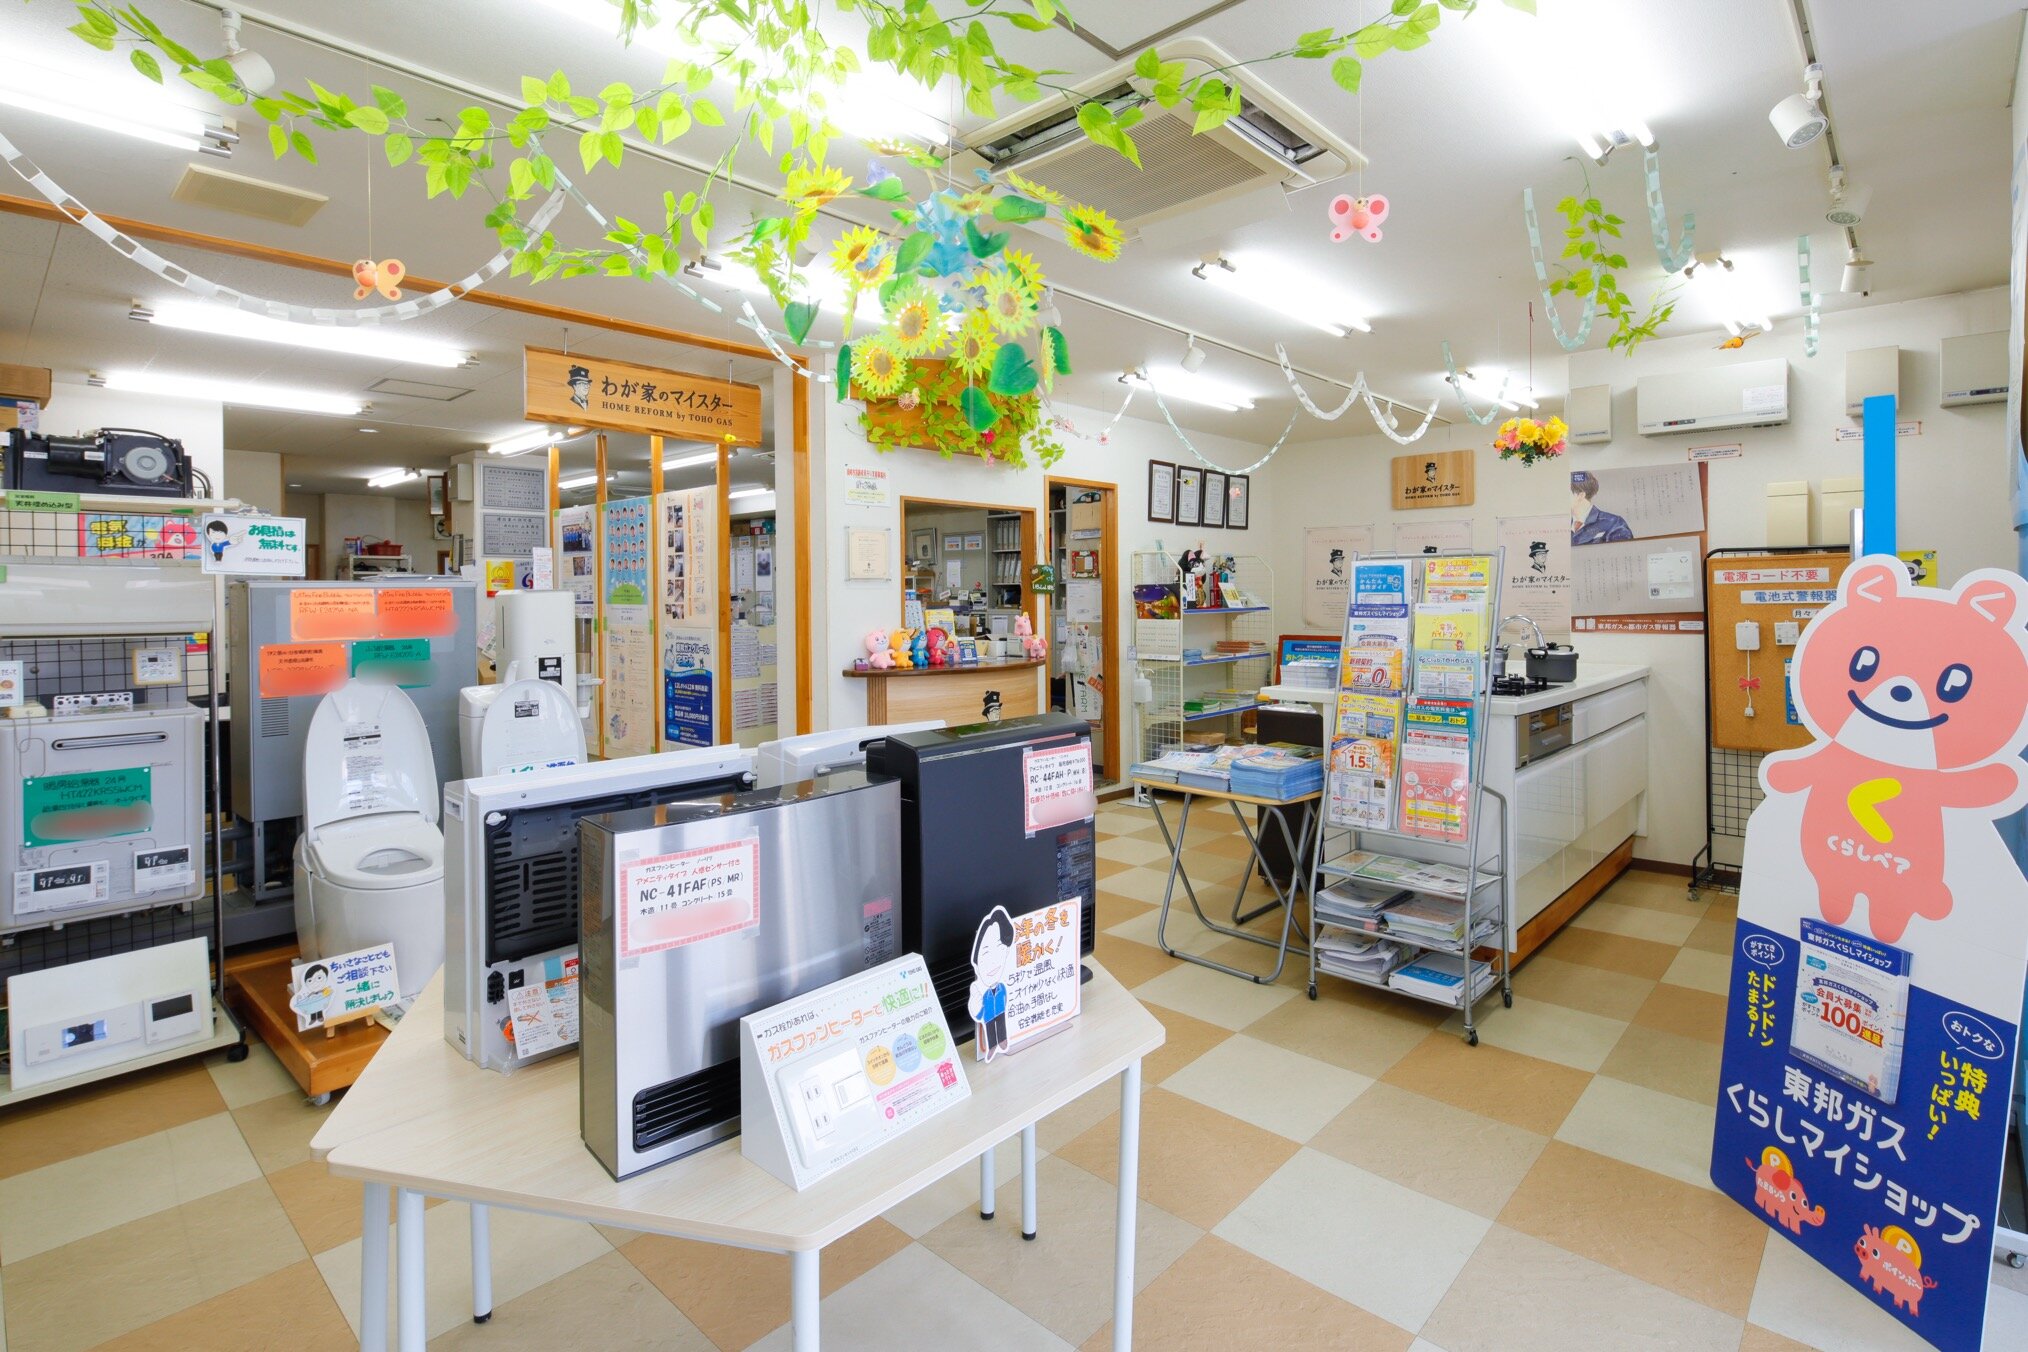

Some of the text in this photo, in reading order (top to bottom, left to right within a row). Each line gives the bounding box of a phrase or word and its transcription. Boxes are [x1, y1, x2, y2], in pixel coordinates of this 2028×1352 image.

[601, 376, 733, 412] わが家のマイスター
[602, 401, 733, 427] HOME REFORM by TOHO GAS
[1405, 484, 1460, 494] わが家のマイスター
[1511, 576, 1571, 584] わが家のマイスター
[1722, 569, 1819, 583] 電源コード不要
[1754, 589, 1838, 603] 電池式警報器
[645, 861, 690, 873] ガスファンヒーター
[1826, 835, 1911, 875] くらしベア
[635, 870, 688, 886] アメニティタイプ
[1750, 940, 1775, 953] がすてき
[1751, 949, 1775, 960] ポイント
[1807, 932, 1892, 969] 東邦ガスくらしマイショップ
[330, 950, 390, 973] ちいさなことでも
[345, 981, 381, 993] 一緒に
[1816, 987, 1862, 1014] 会員大募集
[1747, 970, 1760, 1038] たまる!
[1761, 973, 1776, 1047] ドンドン
[1820, 1001, 1861, 1035] 100
[764, 1009, 822, 1039] ガス栓があれば、
[1951, 1020, 1995, 1052] おトクな
[1927, 1050, 1958, 1140] いっぱい!
[1954, 1062, 1988, 1120] 特典
[1783, 1065, 1907, 1161] 東邦ガス
[1727, 1083, 1981, 1244] くらしマイショップ
